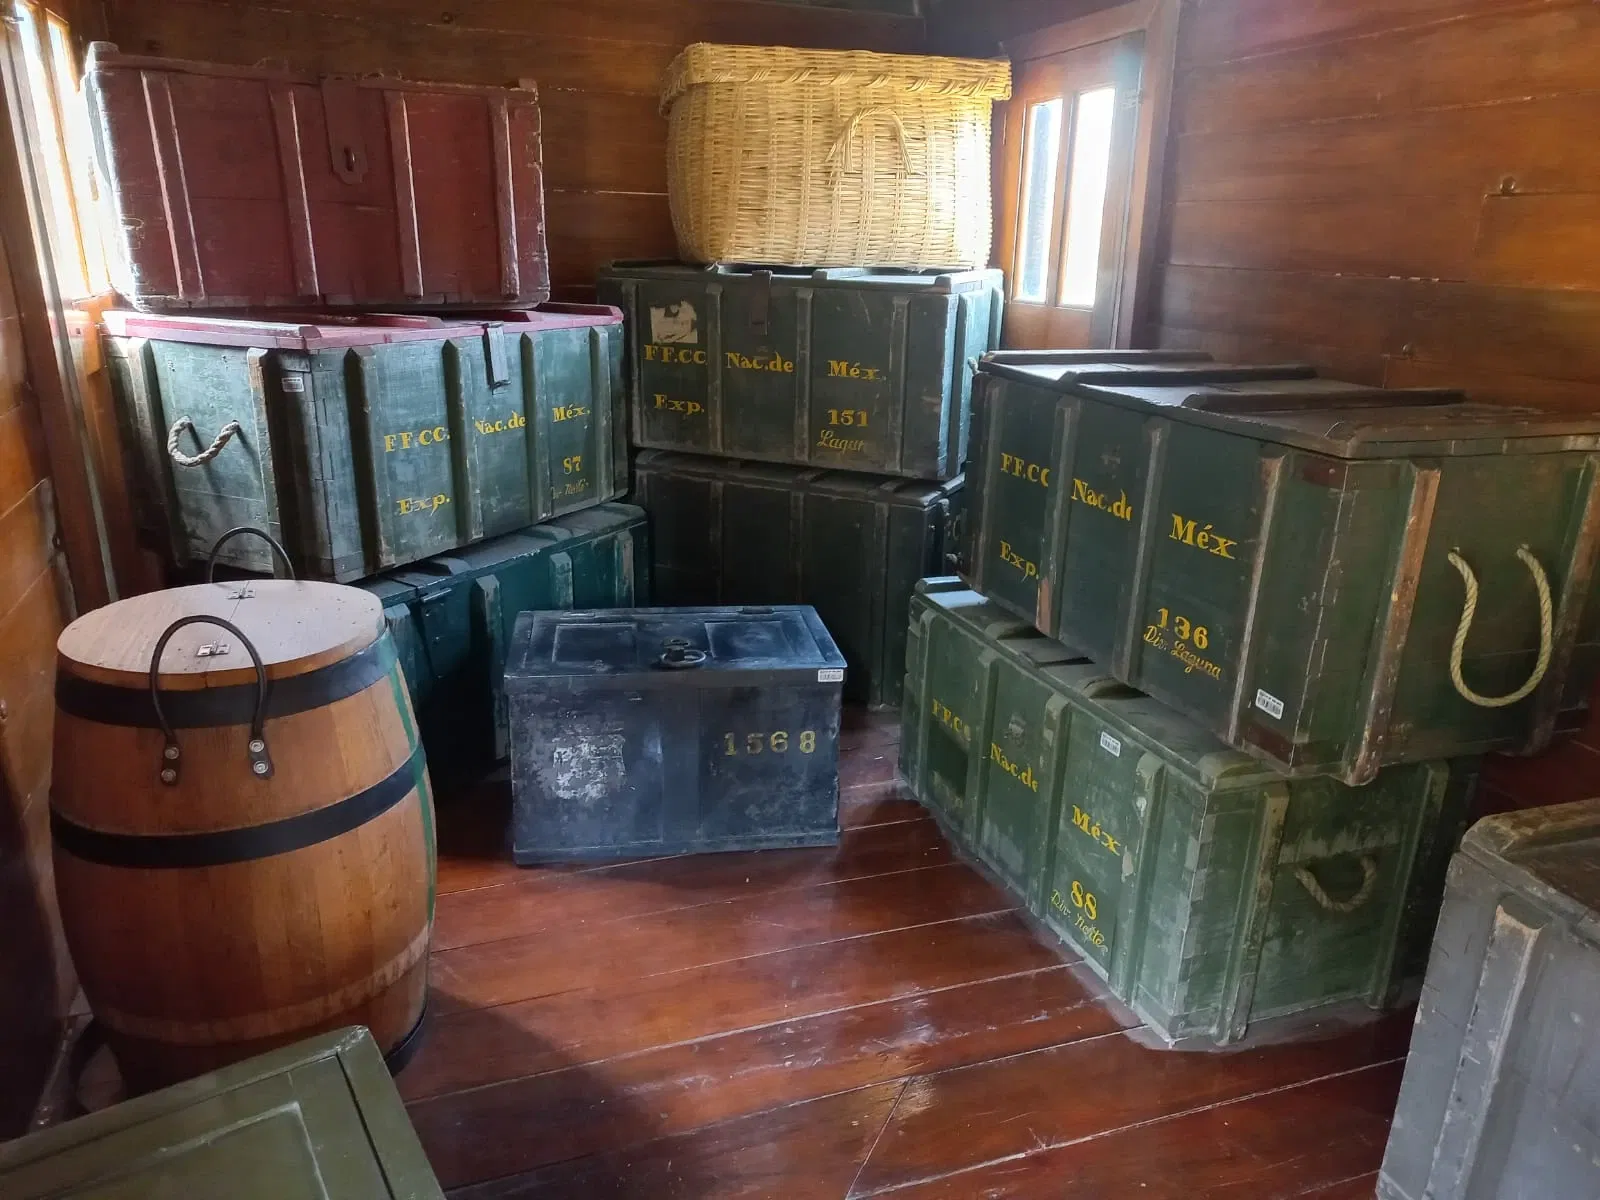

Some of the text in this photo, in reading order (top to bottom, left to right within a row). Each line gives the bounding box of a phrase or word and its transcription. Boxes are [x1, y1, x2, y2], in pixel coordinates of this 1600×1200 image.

[725, 350, 793, 373] Nac.de
[552, 404, 591, 422] Méx.
[654, 394, 705, 416] Exp.
[827, 409, 868, 427] 151
[563, 456, 581, 475] 87
[396, 494, 450, 516] Exp.
[1000, 541, 1039, 583] Exp.
[1157, 608, 1208, 649] 136
[1170, 641, 1221, 680] Laguna
[723, 730, 817, 756] 1568
[1071, 881, 1097, 920] 88
